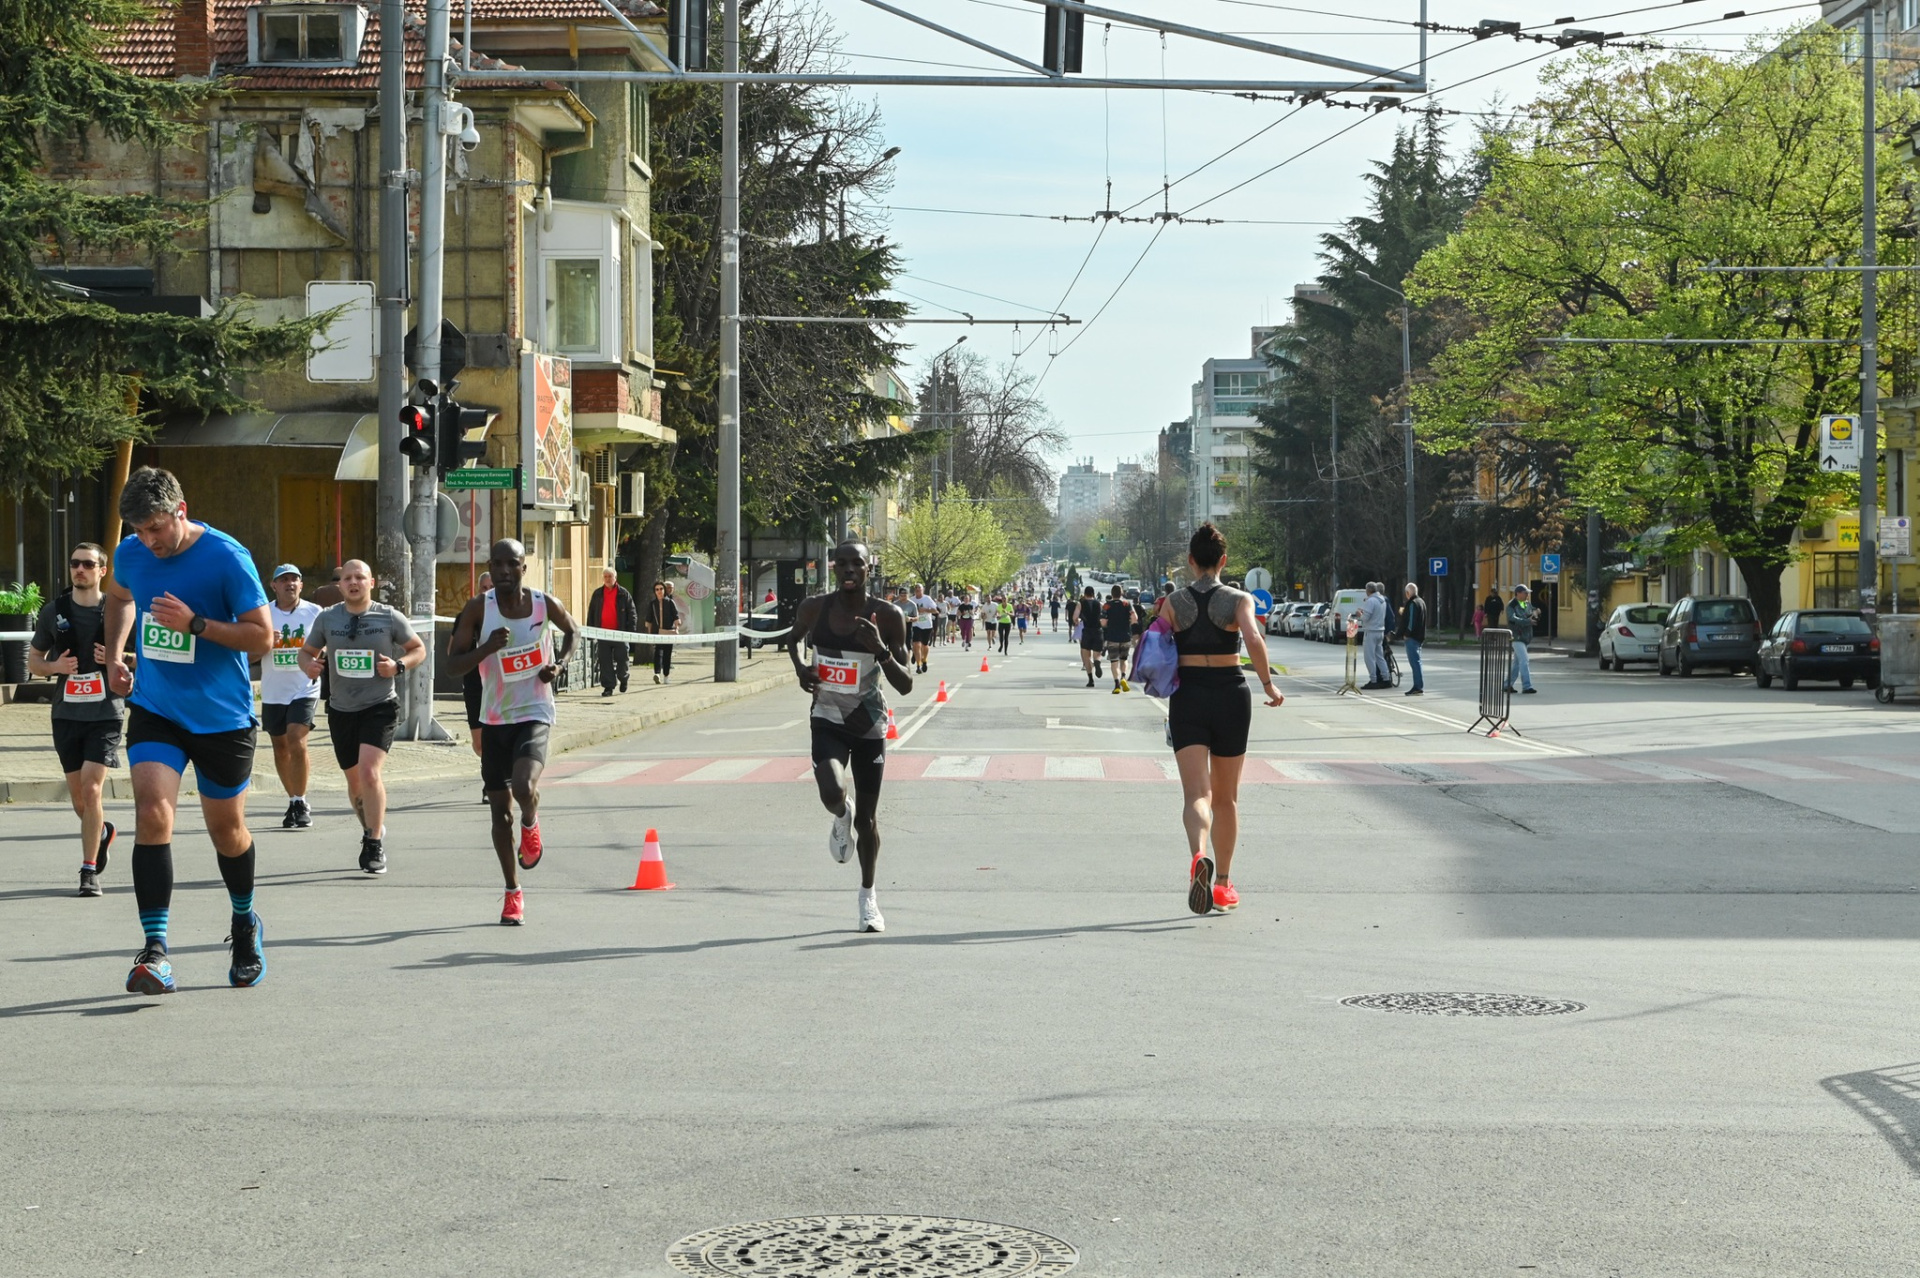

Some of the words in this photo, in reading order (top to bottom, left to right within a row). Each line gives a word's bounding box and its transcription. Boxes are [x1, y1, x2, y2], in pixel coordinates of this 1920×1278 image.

[1433, 560, 1443, 573] P
[148, 627, 184, 649] 930
[341, 657, 367, 669] 891
[513, 655, 533, 670] 61
[826, 668, 846, 683] 20
[73, 682, 93, 694] 26
